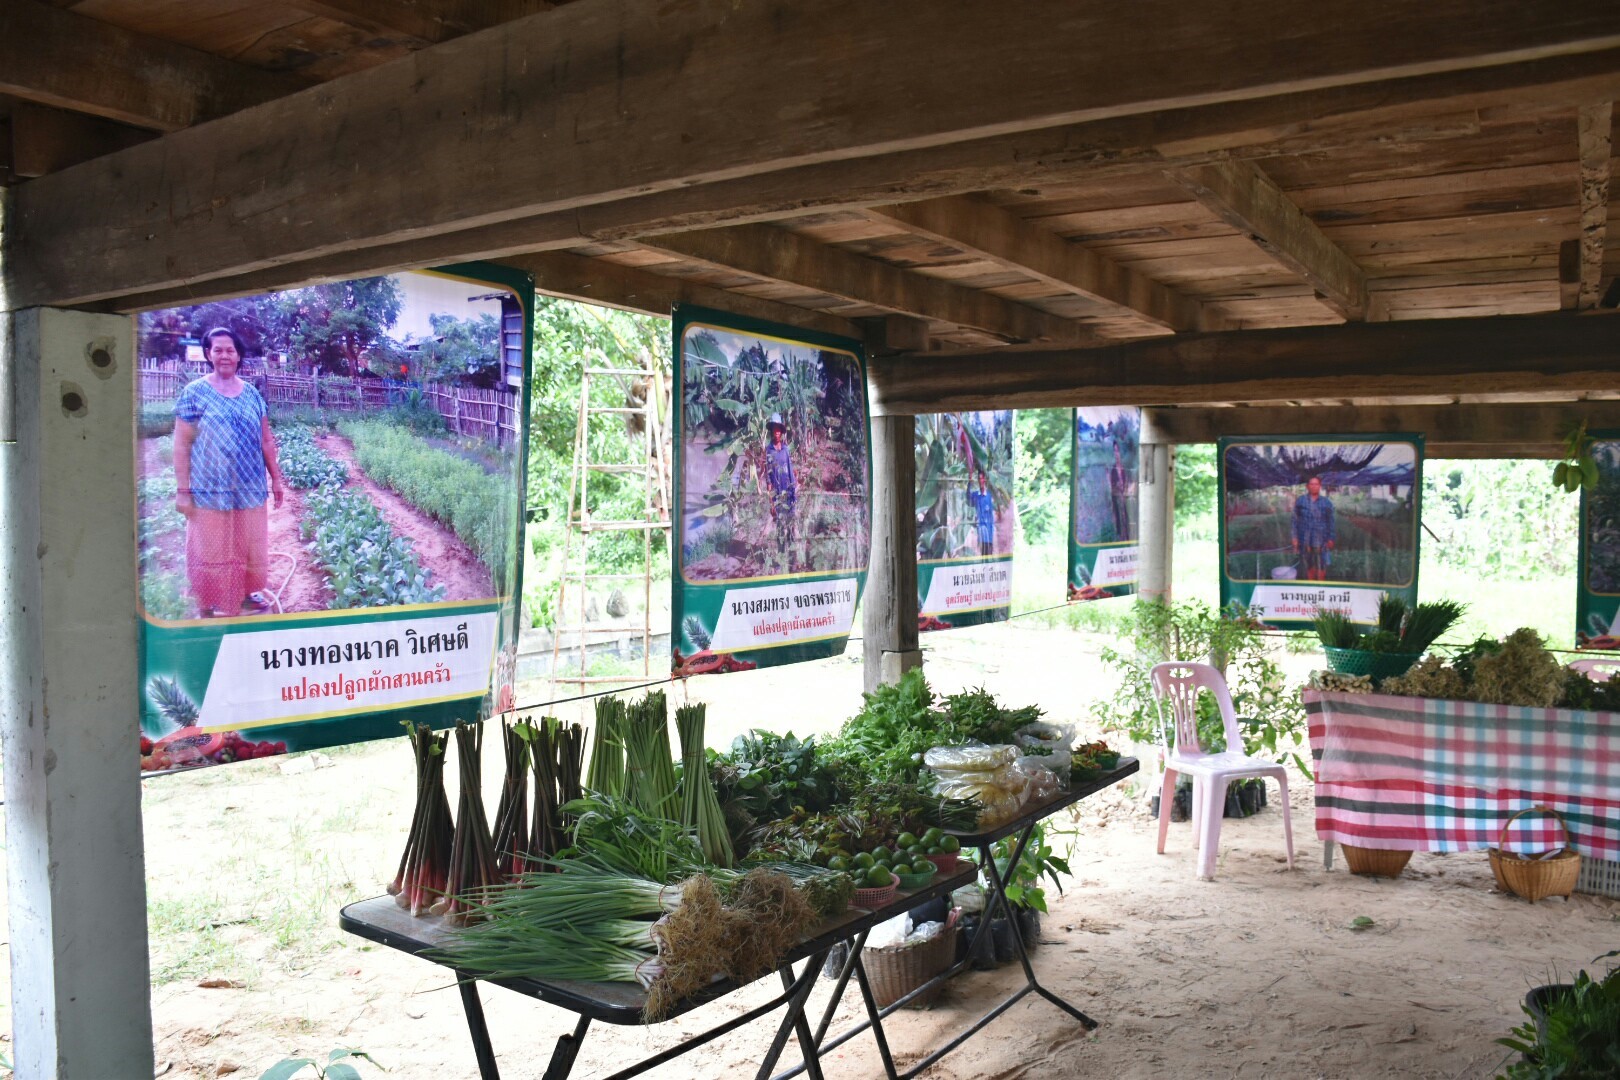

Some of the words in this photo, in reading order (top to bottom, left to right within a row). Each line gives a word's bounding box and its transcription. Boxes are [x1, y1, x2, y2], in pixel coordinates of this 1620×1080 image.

[732, 596, 790, 615] นางสมทรง
[794, 589, 851, 608] ขจรพรมราช
[1280, 590, 1325, 604] นางบุญมี
[260, 638, 399, 670] นางทองนาค
[405, 622, 469, 654] วิเศษดี
[280, 662, 451, 701] แปลงปลูกผักสวนครัว
